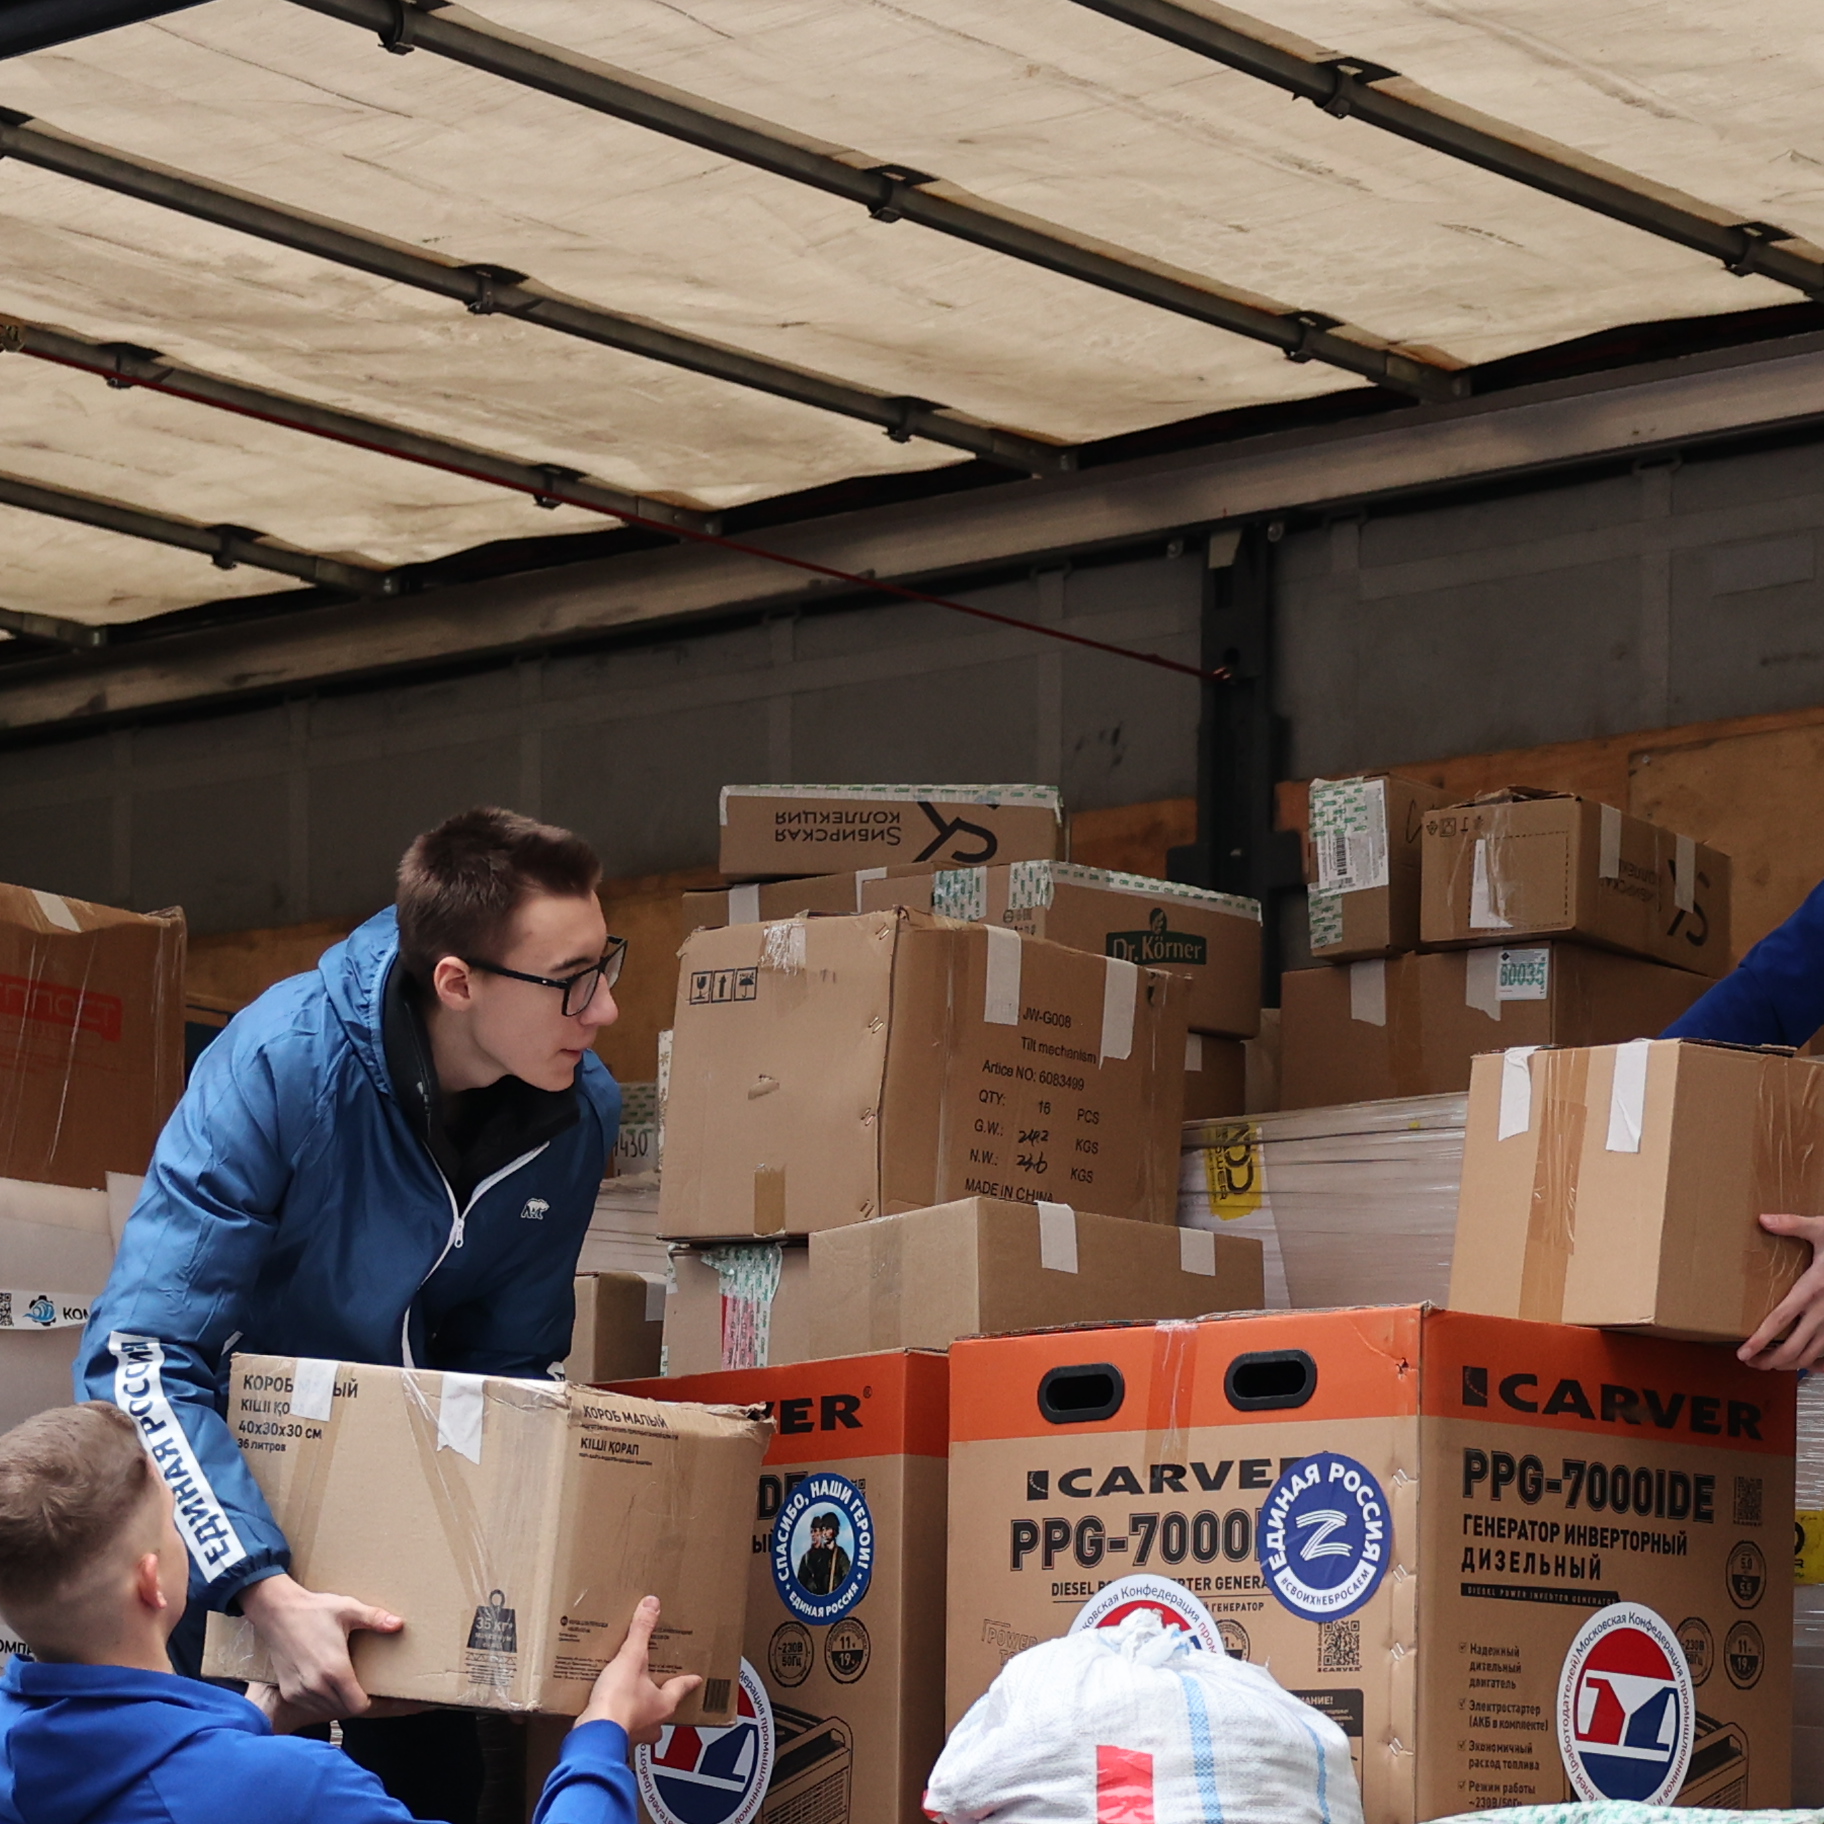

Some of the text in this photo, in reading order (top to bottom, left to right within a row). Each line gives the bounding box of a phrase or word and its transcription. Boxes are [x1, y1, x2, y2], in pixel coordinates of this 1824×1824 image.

[774, 810, 900, 825] КОЛЛЕКЦИЯ
[1113, 936, 1202, 961] Dr. Körner
[1023, 1007, 1072, 1028] JW-G008
[1021, 1036, 1097, 1064] Tilt mechanism
[1015, 1064, 1037, 1082] NO:
[979, 1089, 1100, 1124] QTY: PCS
[1076, 1138, 1099, 1155] KGS
[1071, 1167, 1094, 1184] KGS
[965, 1178, 1054, 1202] MADE IN CHINA
[243, 1374, 294, 1393] КОРОБ
[583, 1405, 669, 1429] КОРОБ МАЛЫЙ
[1498, 1373, 1764, 1441] CARVER
[121, 1341, 231, 1567] ЕДИНАЯ РОССИЯ
[237, 1438, 287, 1453] 36 литров
[810, 1479, 853, 1504] НАШИ
[1462, 1447, 1716, 1524] PPG-7000IDE
[1266, 1462, 1384, 1571] ЕДИНАЯ РОССИЯ
[1295, 1509, 1353, 1562] Z
[1463, 1513, 1688, 1556] ГЕНЕРАТОР ИНВЕРТОРНЫЙ
[1461, 1546, 1602, 1581] ДИЗЕЛЬНЫЙ
[1051, 1581, 1094, 1597] DIESEL
[1280, 1568, 1370, 1606] #СВОИХНЕБРОСАЕМ
[1467, 1586, 1496, 1597] DIESEL
[1500, 1588, 1525, 1599] POWER
[788, 1581, 860, 1618] ЕДИНАЯ РОССИЯ
[1120, 1583, 1201, 1624] Конфедерация
[1211, 1600, 1265, 1613] ГЕНЕРАТОР
[475, 1616, 492, 1630] 35
[1469, 1643, 1520, 1658] Надежный
[1469, 1678, 1517, 1690] двигатель
[1469, 1699, 1541, 1717] Электростартер
[1576, 1614, 1627, 1658] Московская
[1628, 1611, 1684, 1678] Конфедерация
[1664, 1679, 1690, 1797] промышленников
[1469, 1715, 1549, 1732] (АКБ в комплекте)
[1468, 1740, 1533, 1754] Экономичный
[1468, 1758, 1540, 1771] расход топлива
[1468, 1780, 1536, 1795] Режим работы
